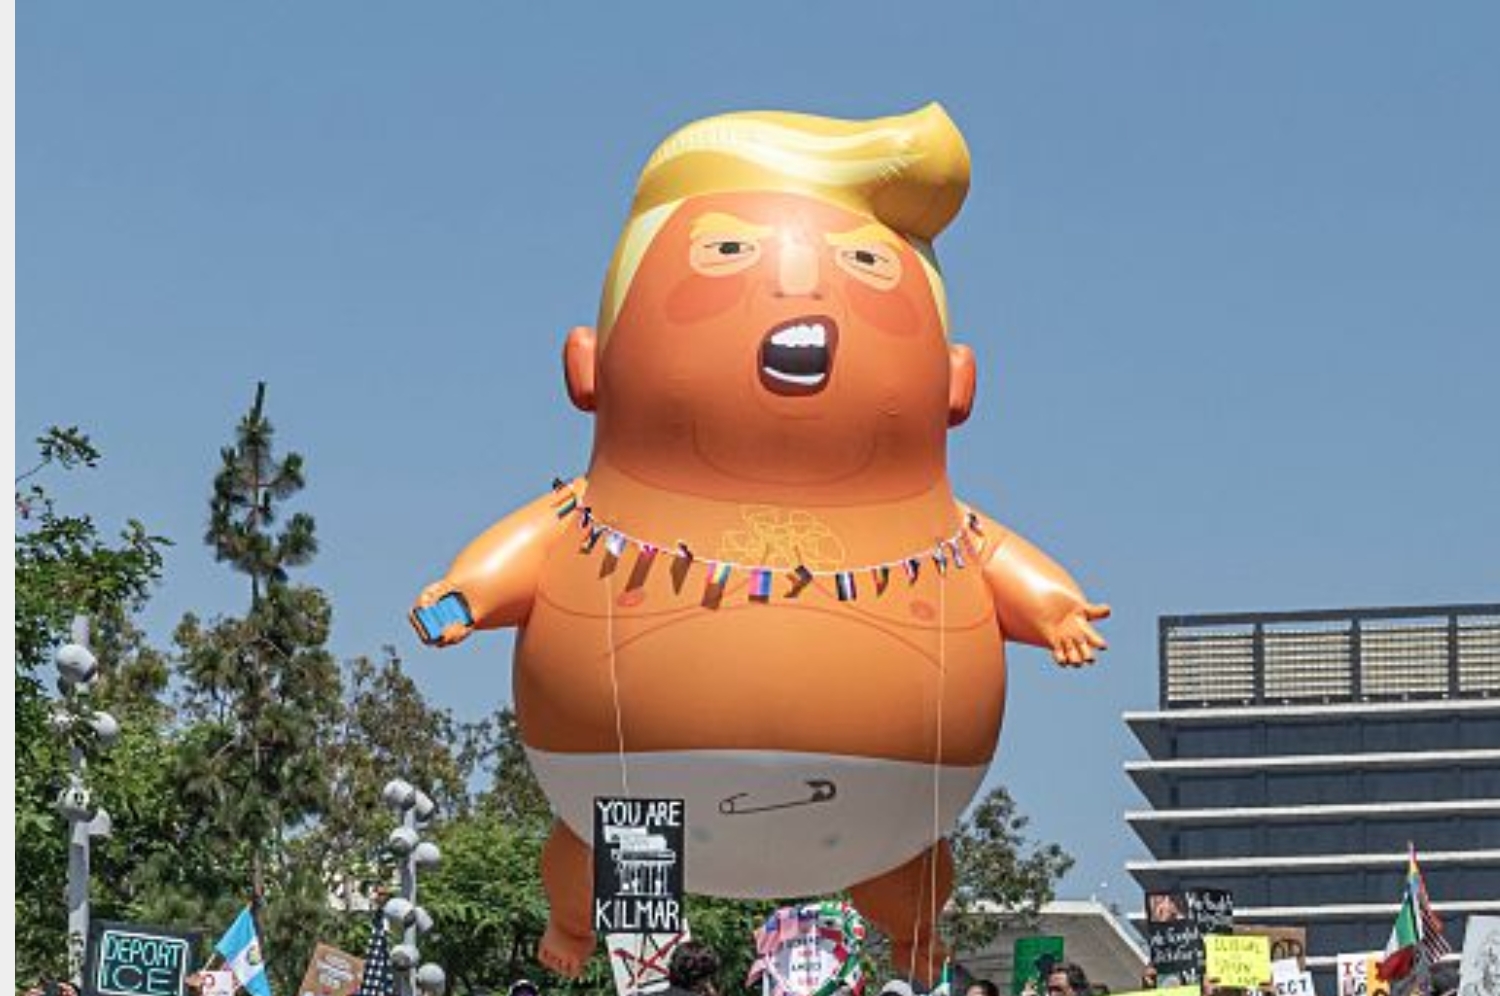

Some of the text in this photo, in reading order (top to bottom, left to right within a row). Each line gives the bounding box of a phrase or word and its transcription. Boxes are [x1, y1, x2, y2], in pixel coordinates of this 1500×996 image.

[596, 801, 681, 826] YOU ARE
[596, 898, 679, 930] KILMAR
[104, 937, 180, 969] DEPORT
